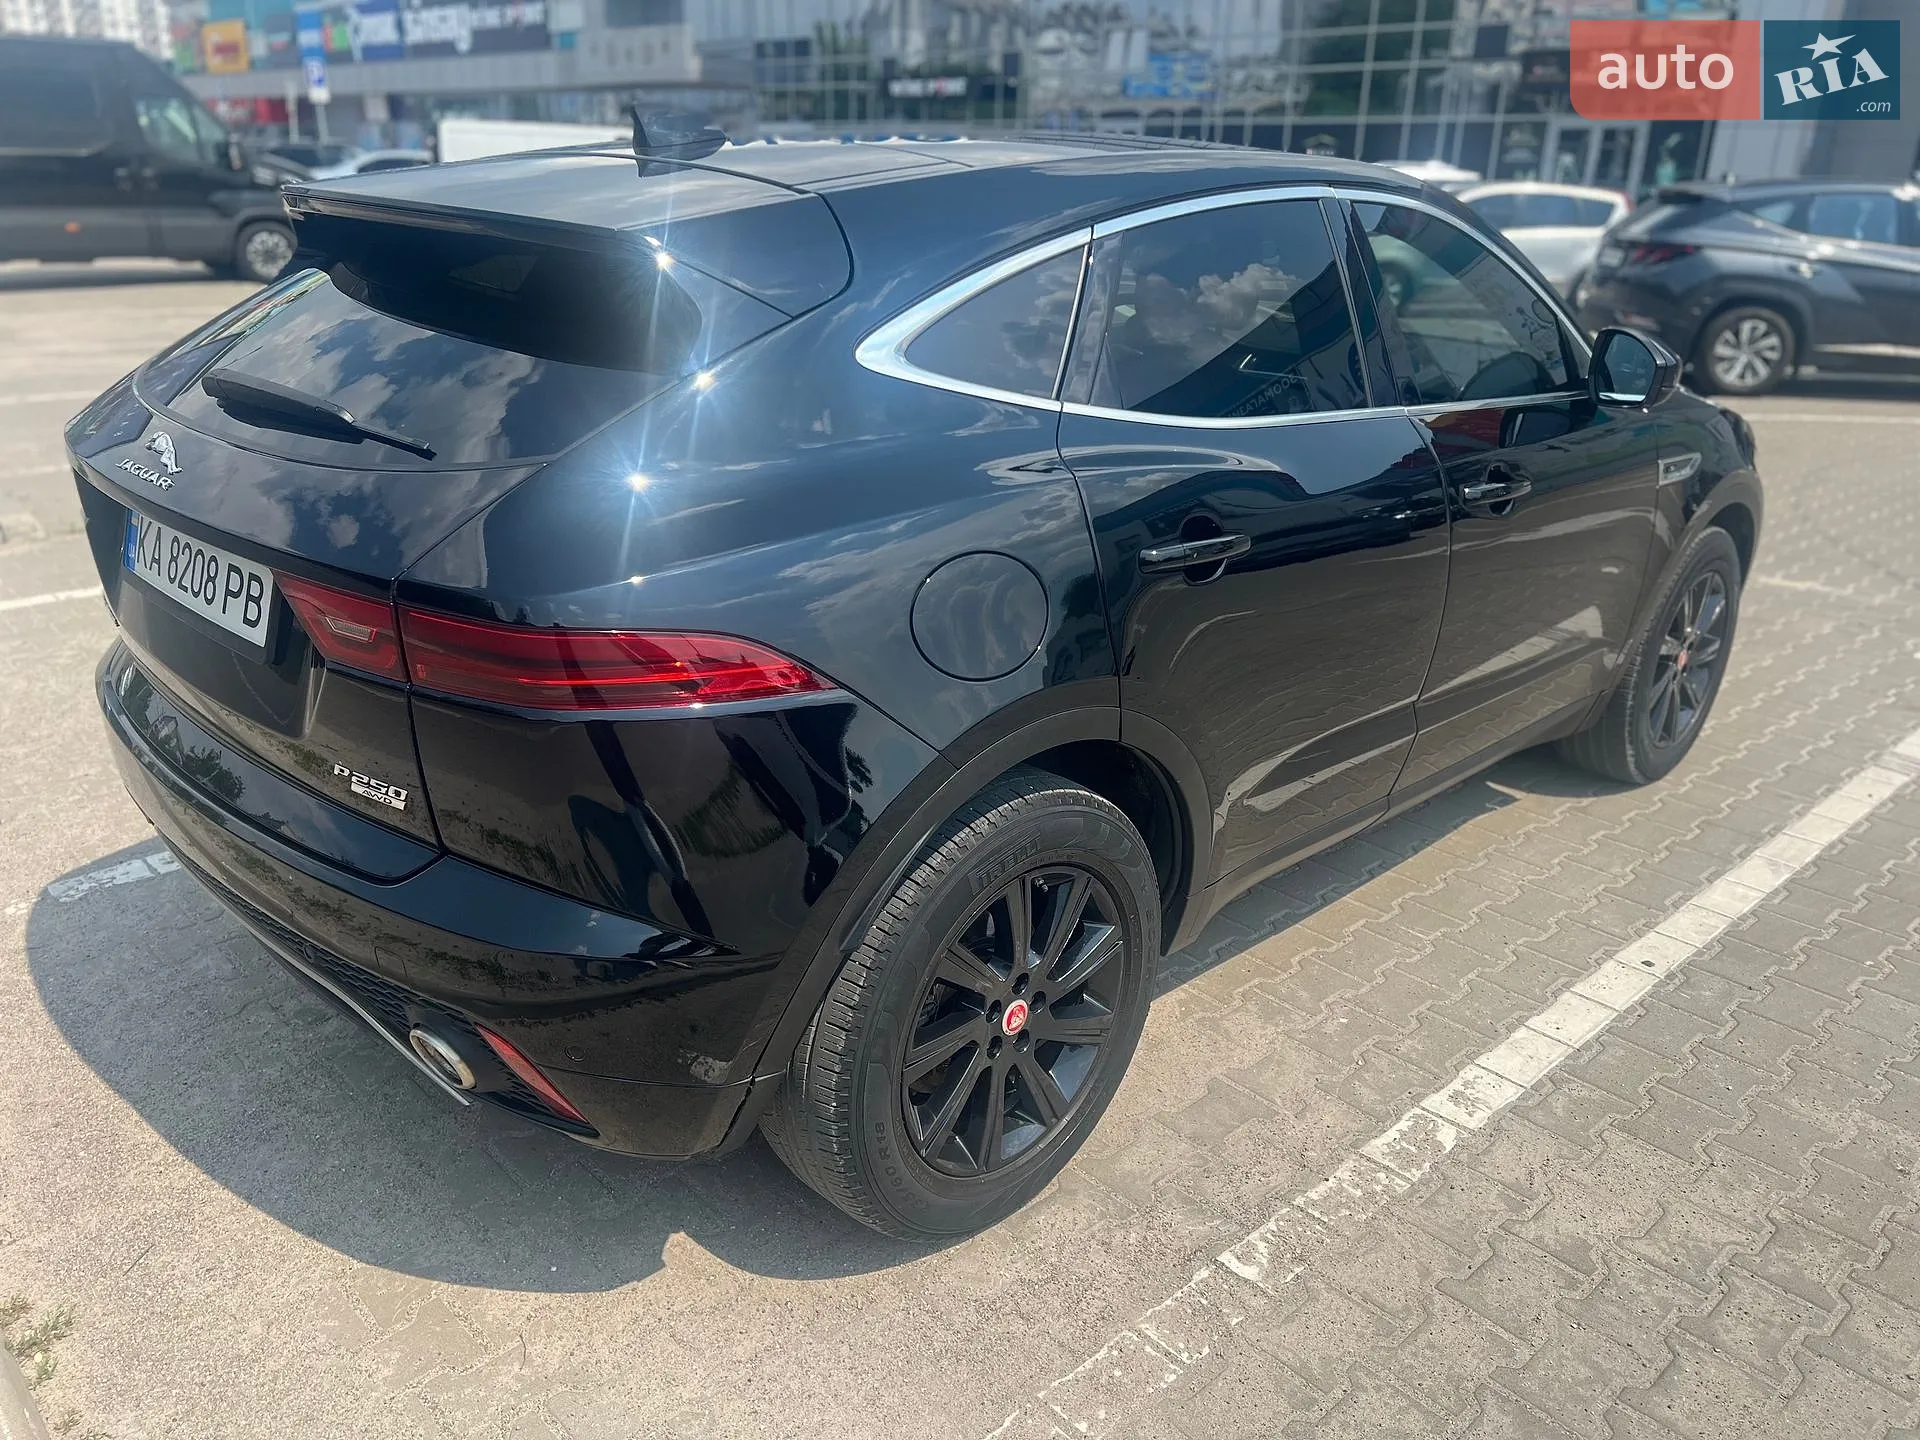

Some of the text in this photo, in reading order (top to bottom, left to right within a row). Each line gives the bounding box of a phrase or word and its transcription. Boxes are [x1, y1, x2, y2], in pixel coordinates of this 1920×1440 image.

[115, 459, 176, 490] JAGUAR
[137, 516, 264, 629] KA 8208 PB
[334, 763, 408, 801] P250
[361, 789, 392, 804] AWD
